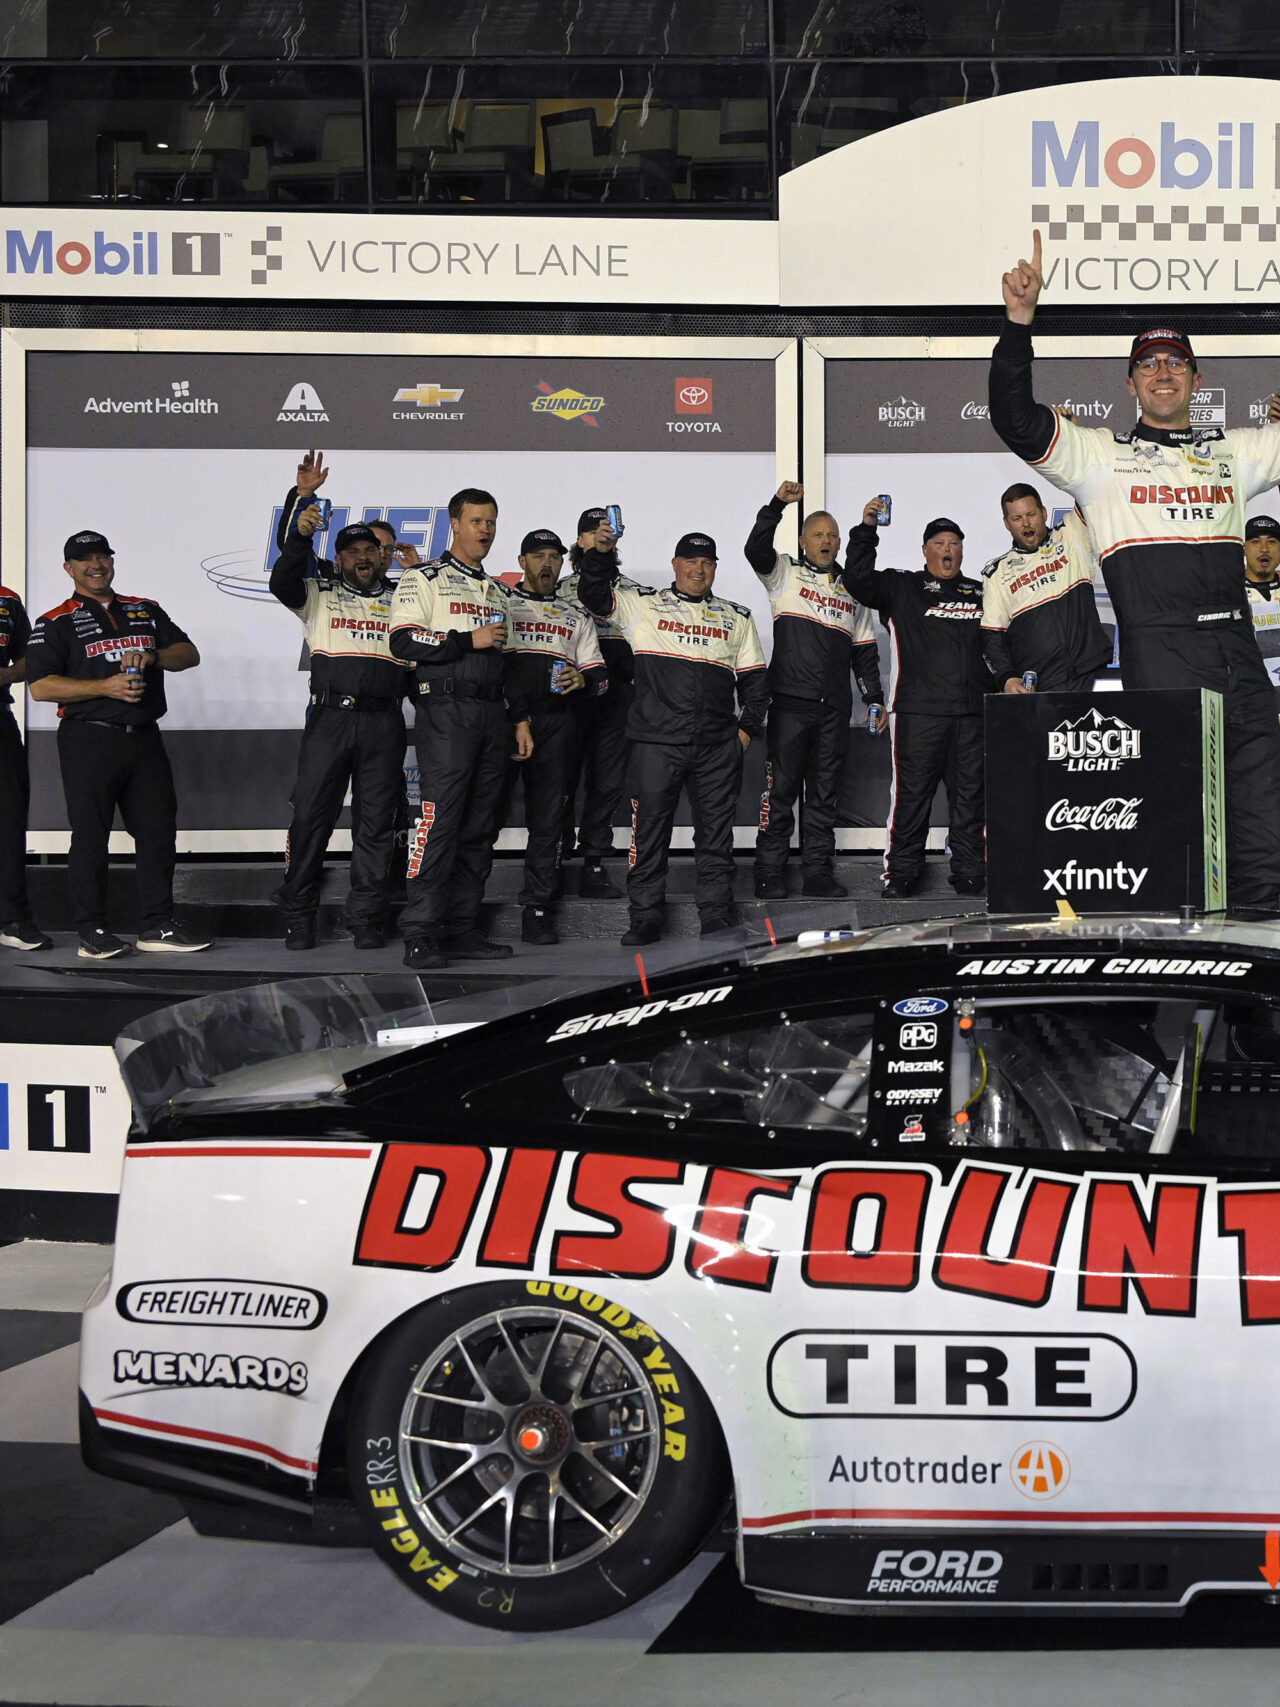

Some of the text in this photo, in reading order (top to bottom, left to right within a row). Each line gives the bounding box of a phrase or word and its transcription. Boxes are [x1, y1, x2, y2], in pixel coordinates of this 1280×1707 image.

[1032, 120, 1254, 189] Mobil
[5, 229, 158, 276] Mobil
[307, 240, 500, 277] VICTORY
[514, 243, 629, 278] LANE
[535, 396, 604, 413] SUNOCO
[878, 406, 926, 422] BUSCH
[1051, 399, 1114, 419] finity
[276, 412, 330, 422] AXALTA
[392, 412, 465, 421] CHEVROLET
[666, 423, 722, 433] TOYOTA
[1129, 485, 1235, 504] DISCOUNT
[1166, 507, 1216, 521] TIRE
[1009, 555, 1069, 595] DISCOUNT
[1029, 574, 1057, 592] TIRE
[924, 610, 983, 620] PENSKE
[937, 601, 978, 610] TEAM
[1197, 611, 1232, 622] CINDRIC
[350, 631, 385, 642] TIRE
[520, 633, 554, 644] TIRE
[657, 619, 730, 641] DISCOUNT
[86, 635, 156, 658] DISCOUNT
[415, 635, 437, 645] TIRE
[677, 635, 709, 647] TIRE
[1048, 729, 1141, 760] BUSCH
[1067, 759, 1121, 772] LIGHT
[1045, 797, 1144, 831] Coca-Cola
[406, 801, 435, 878] DISCOUNT
[1043, 860, 1149, 896] xfinity
[956, 958, 1253, 977] AUSTIN CINDRIC
[902, 1025, 935, 1047] PPG
[887, 1059, 945, 1073] Mazak
[886, 1088, 943, 1100] ODYSSEY
[136, 1290, 311, 1319] FREIGHTLINER
[113, 1349, 308, 1396] MENARDS
[805, 1343, 1092, 1408] TIRE
[828, 1454, 1003, 1484] Autotrader
[370, 1487, 460, 1592] EAGLE
[870, 1549, 1004, 1579] FORD
[867, 1579, 999, 1594] PERFORMANCE
